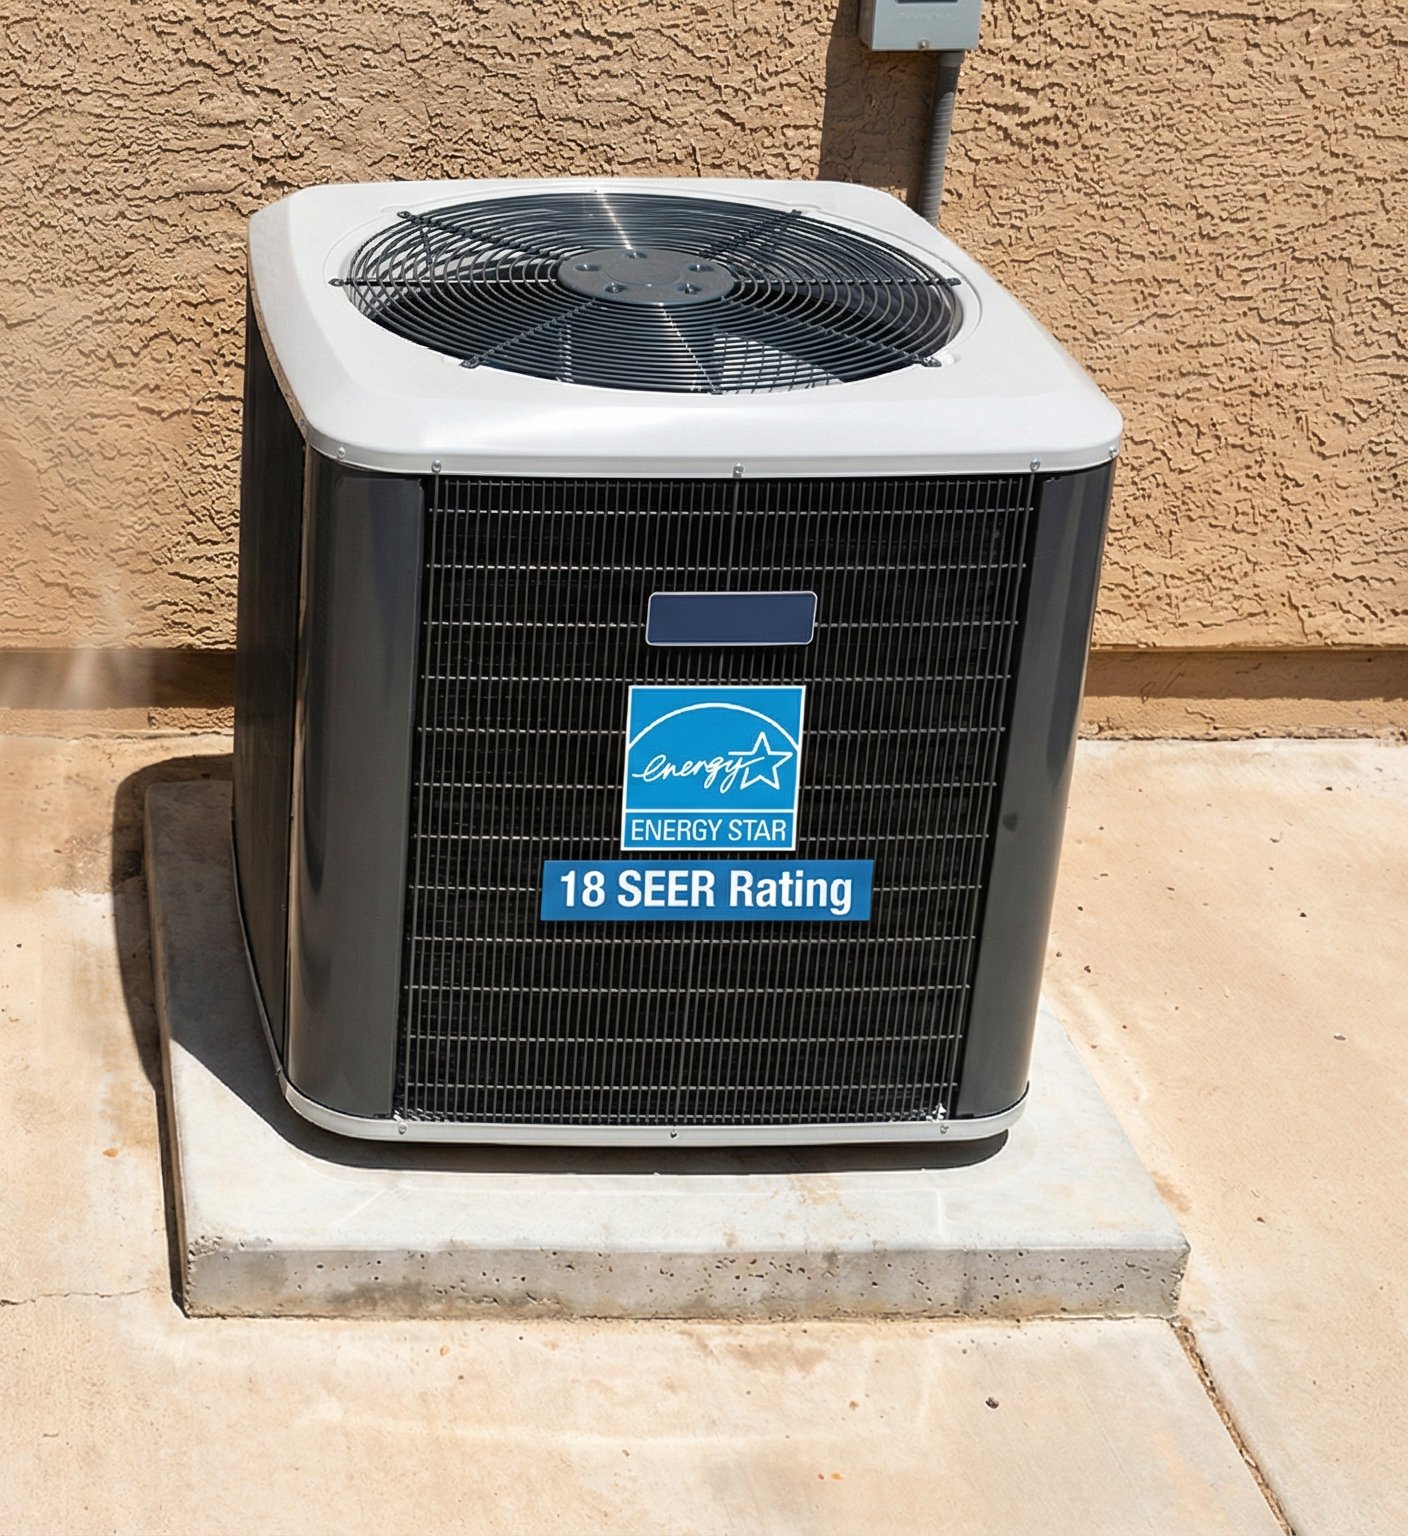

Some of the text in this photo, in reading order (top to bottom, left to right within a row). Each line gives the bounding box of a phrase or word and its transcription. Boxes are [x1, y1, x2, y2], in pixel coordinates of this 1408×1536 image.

[631, 754, 765, 794] energy
[630, 819, 787, 842] ENERGY STAR
[560, 869, 853, 916] 18 SEER Rating
